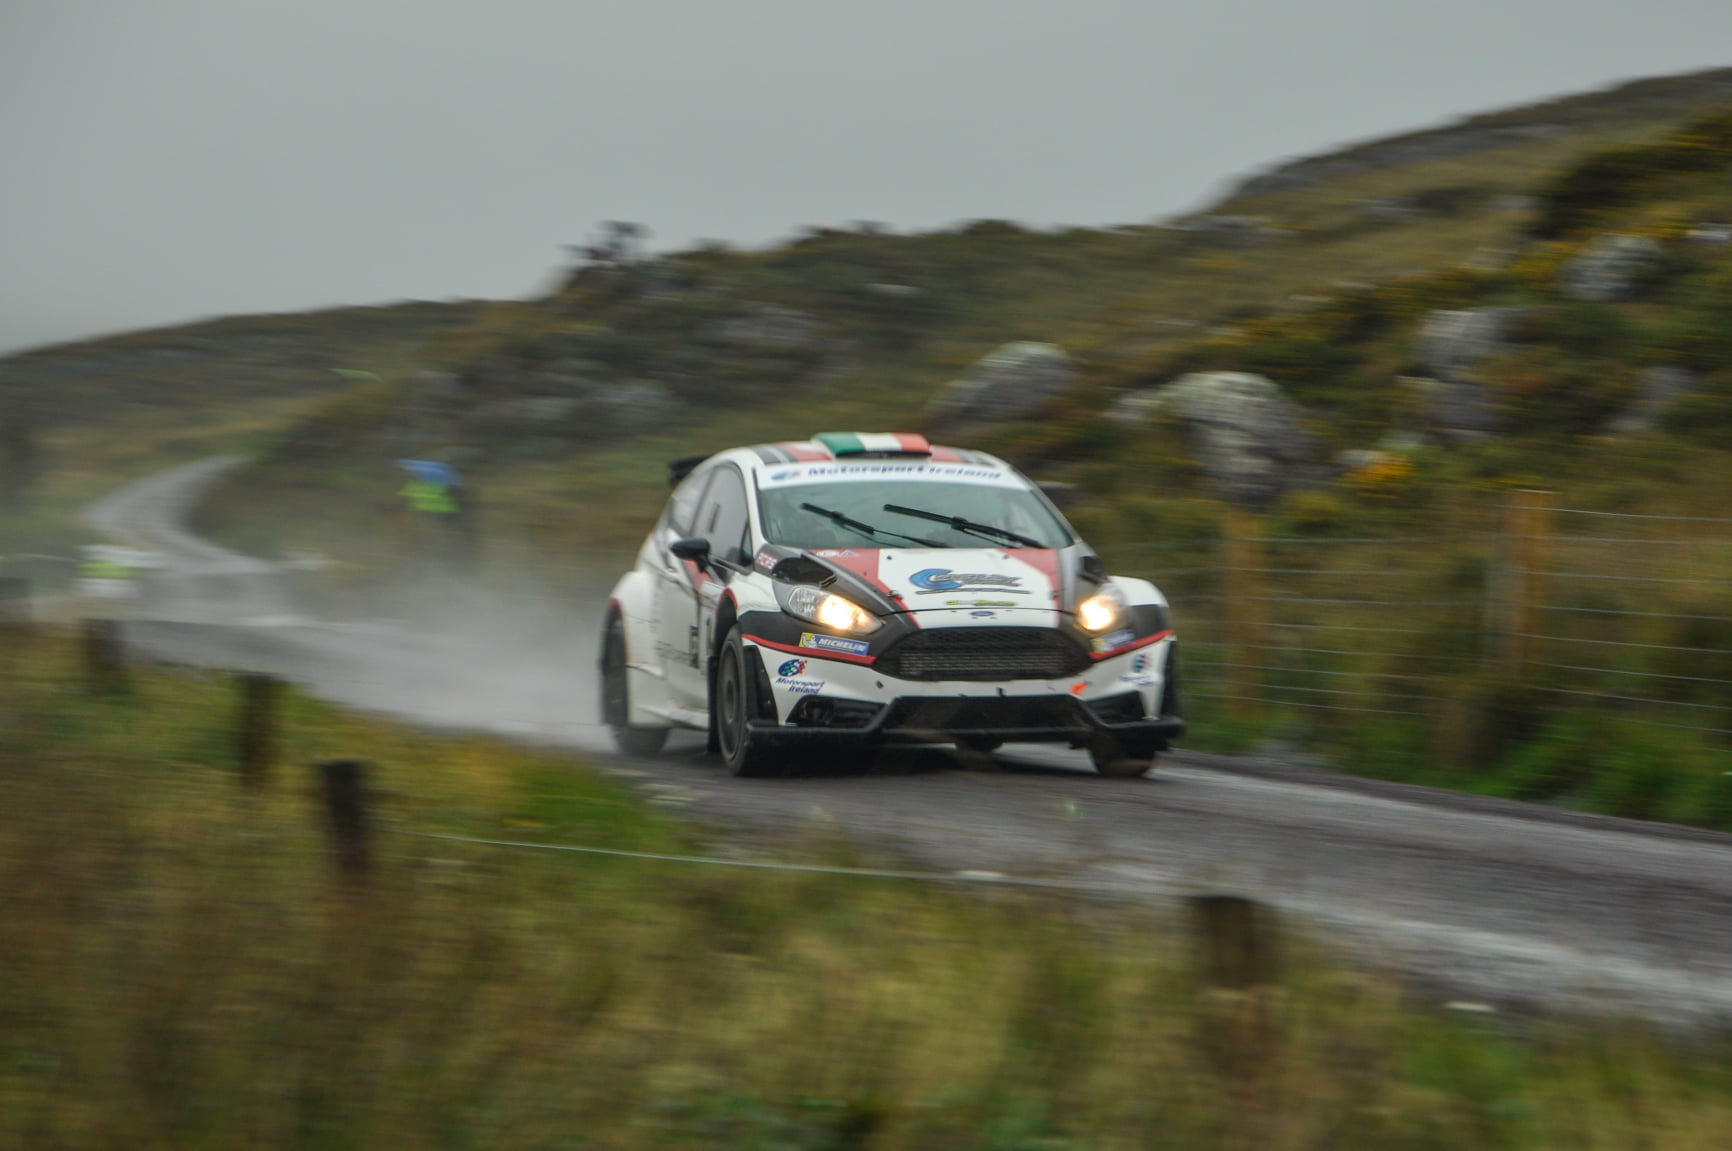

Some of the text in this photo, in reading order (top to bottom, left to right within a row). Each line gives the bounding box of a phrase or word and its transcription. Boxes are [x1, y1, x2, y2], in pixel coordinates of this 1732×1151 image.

[818, 638, 868, 652] MICHELIN
[775, 677, 825, 688] Motorsport
[788, 685, 821, 695] Ireland
